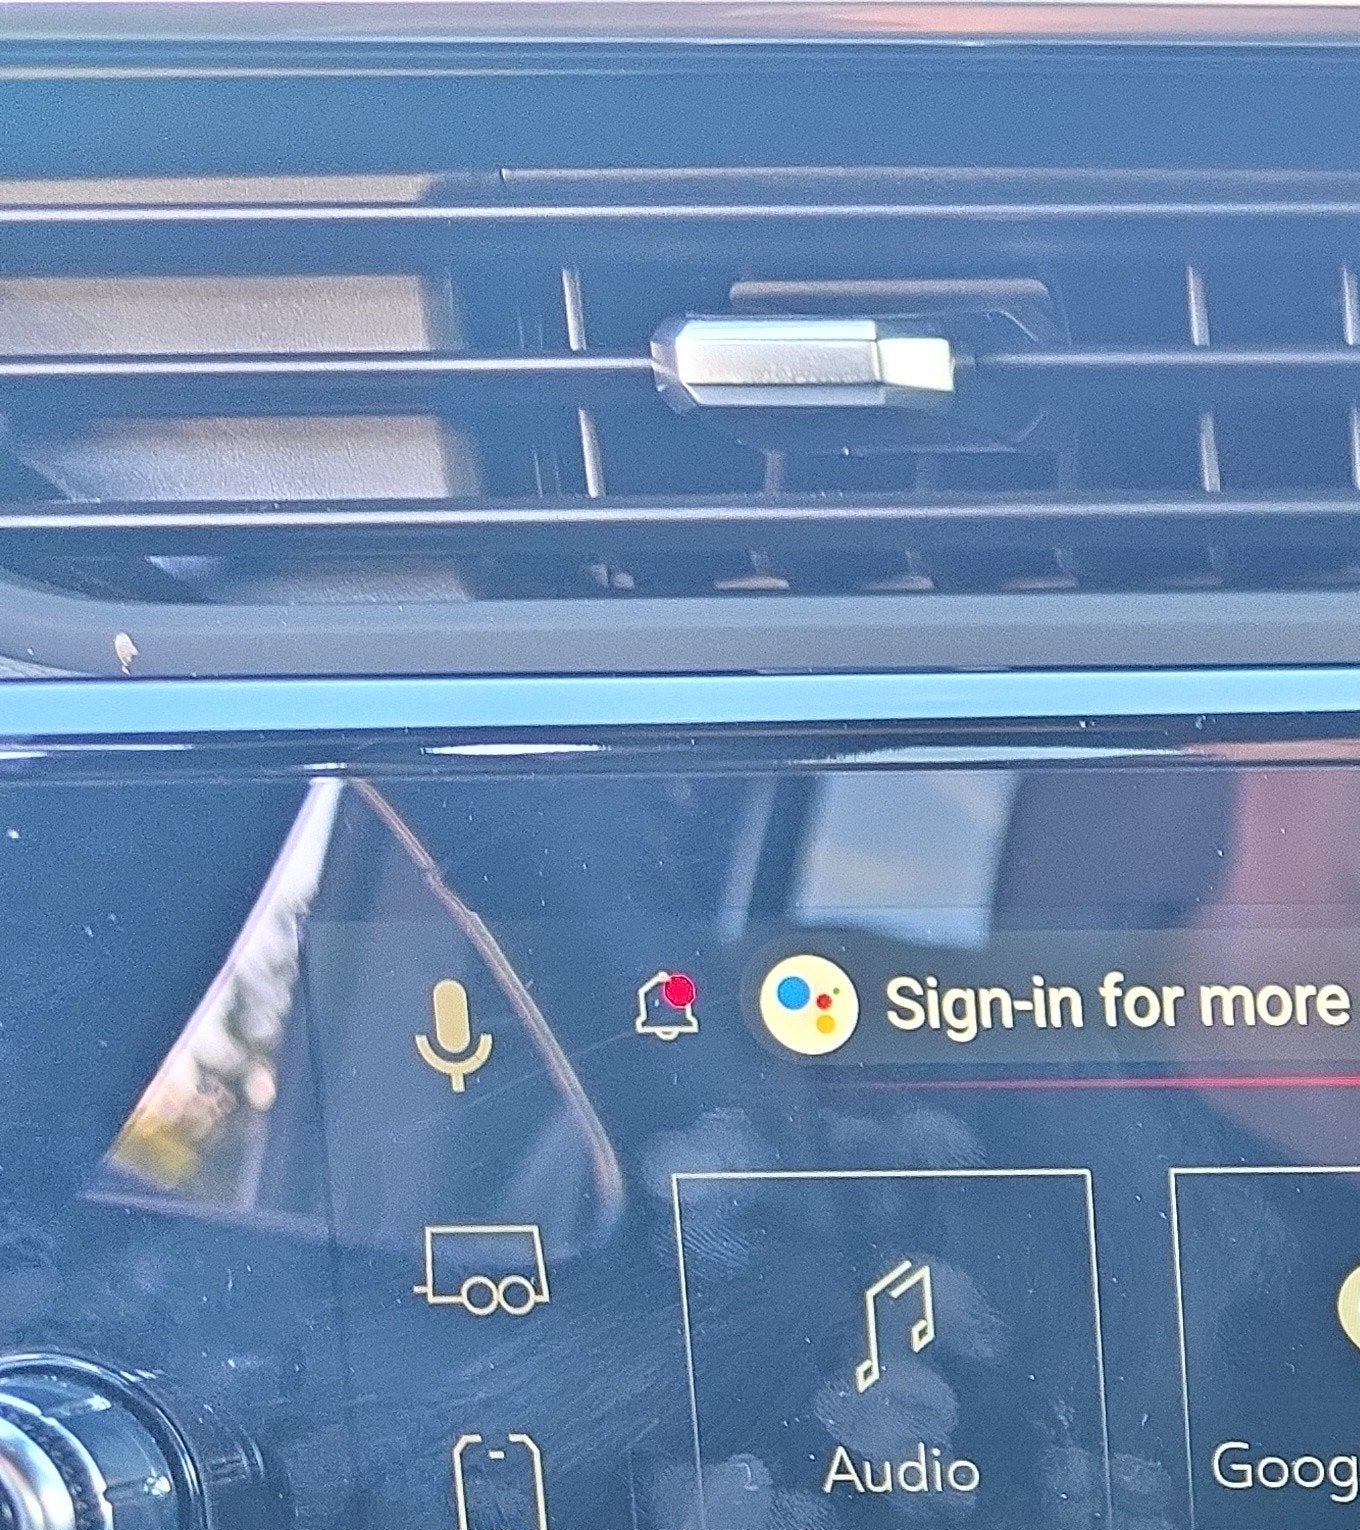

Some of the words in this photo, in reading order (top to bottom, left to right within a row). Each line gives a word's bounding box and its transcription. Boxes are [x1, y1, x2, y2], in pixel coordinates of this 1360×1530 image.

[884, 975, 1084, 1043] Sign-in
[1098, 972, 1184, 1026] for
[1198, 986, 1350, 1025] more
[822, 1442, 981, 1495] Audio
